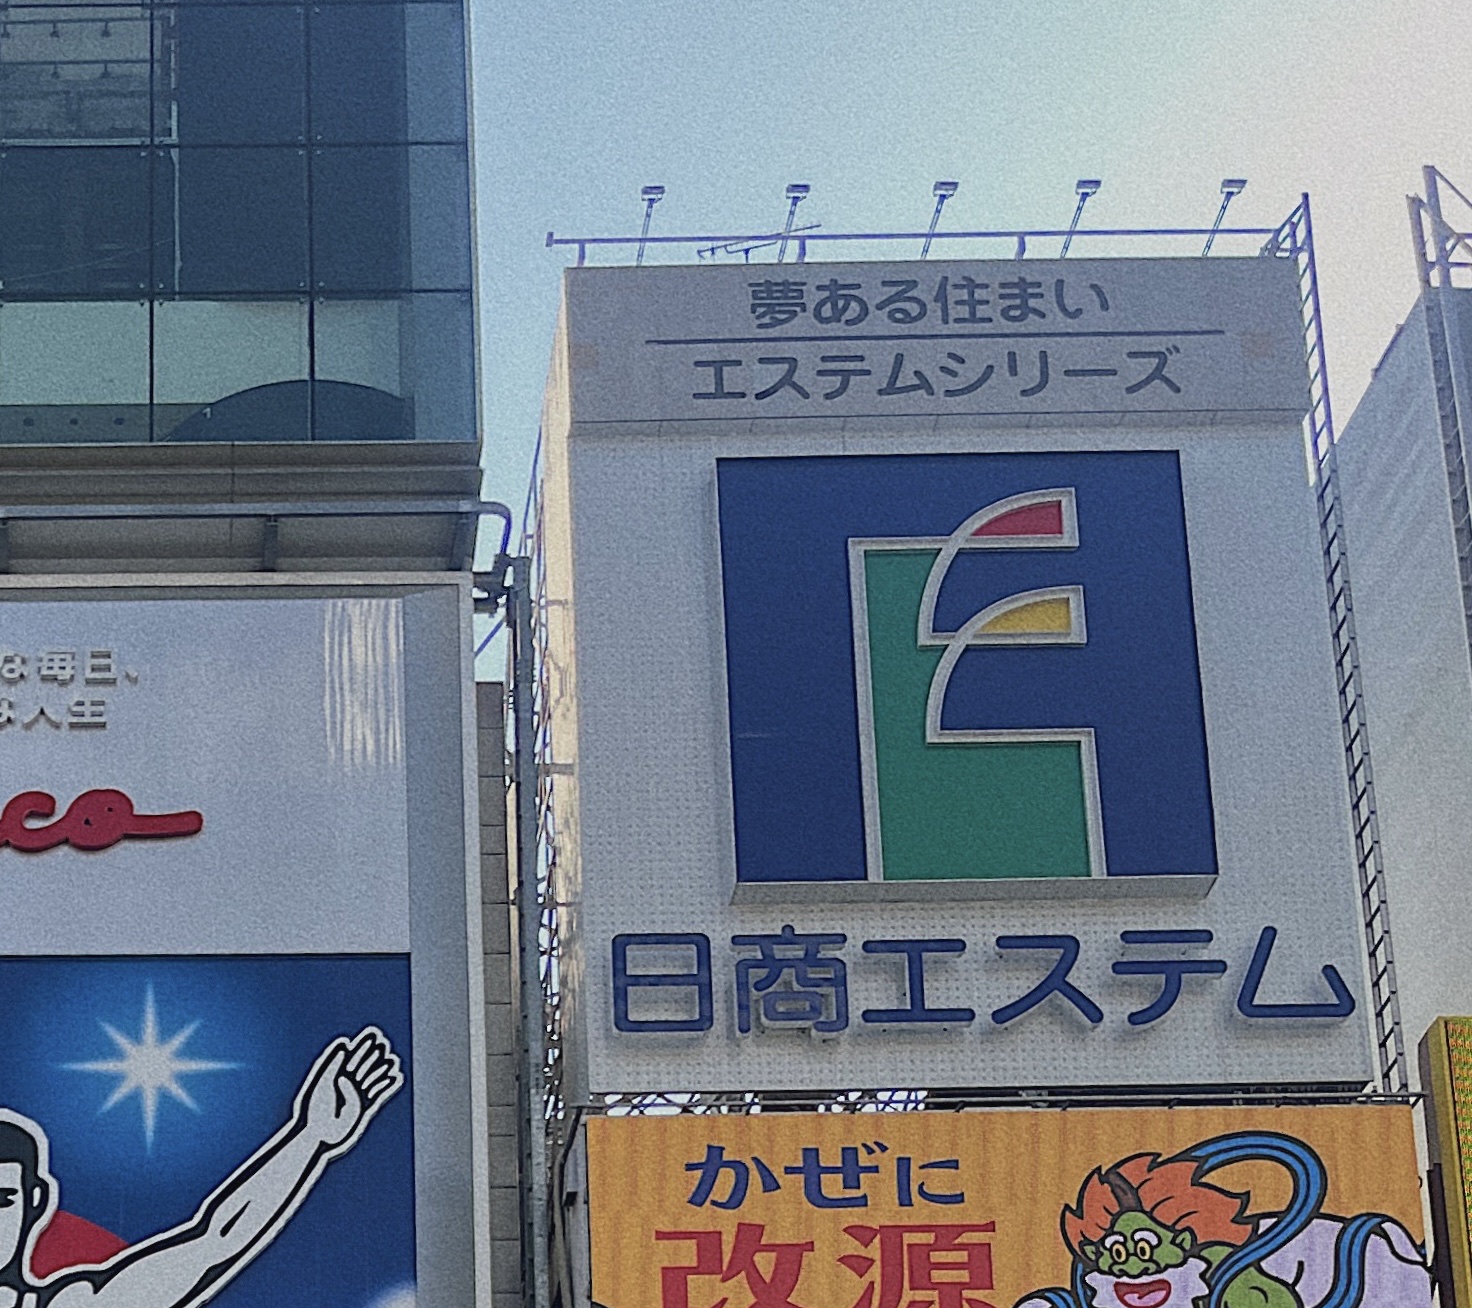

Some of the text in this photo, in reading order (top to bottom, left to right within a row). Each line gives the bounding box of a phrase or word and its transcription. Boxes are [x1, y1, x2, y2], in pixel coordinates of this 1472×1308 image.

[748, 276, 1111, 328] 夢ある住まい
[692, 345, 1183, 401] エステムシリーズ
[611, 924, 1356, 1035] 日商エステム
[684, 1140, 965, 1210] かぜに
